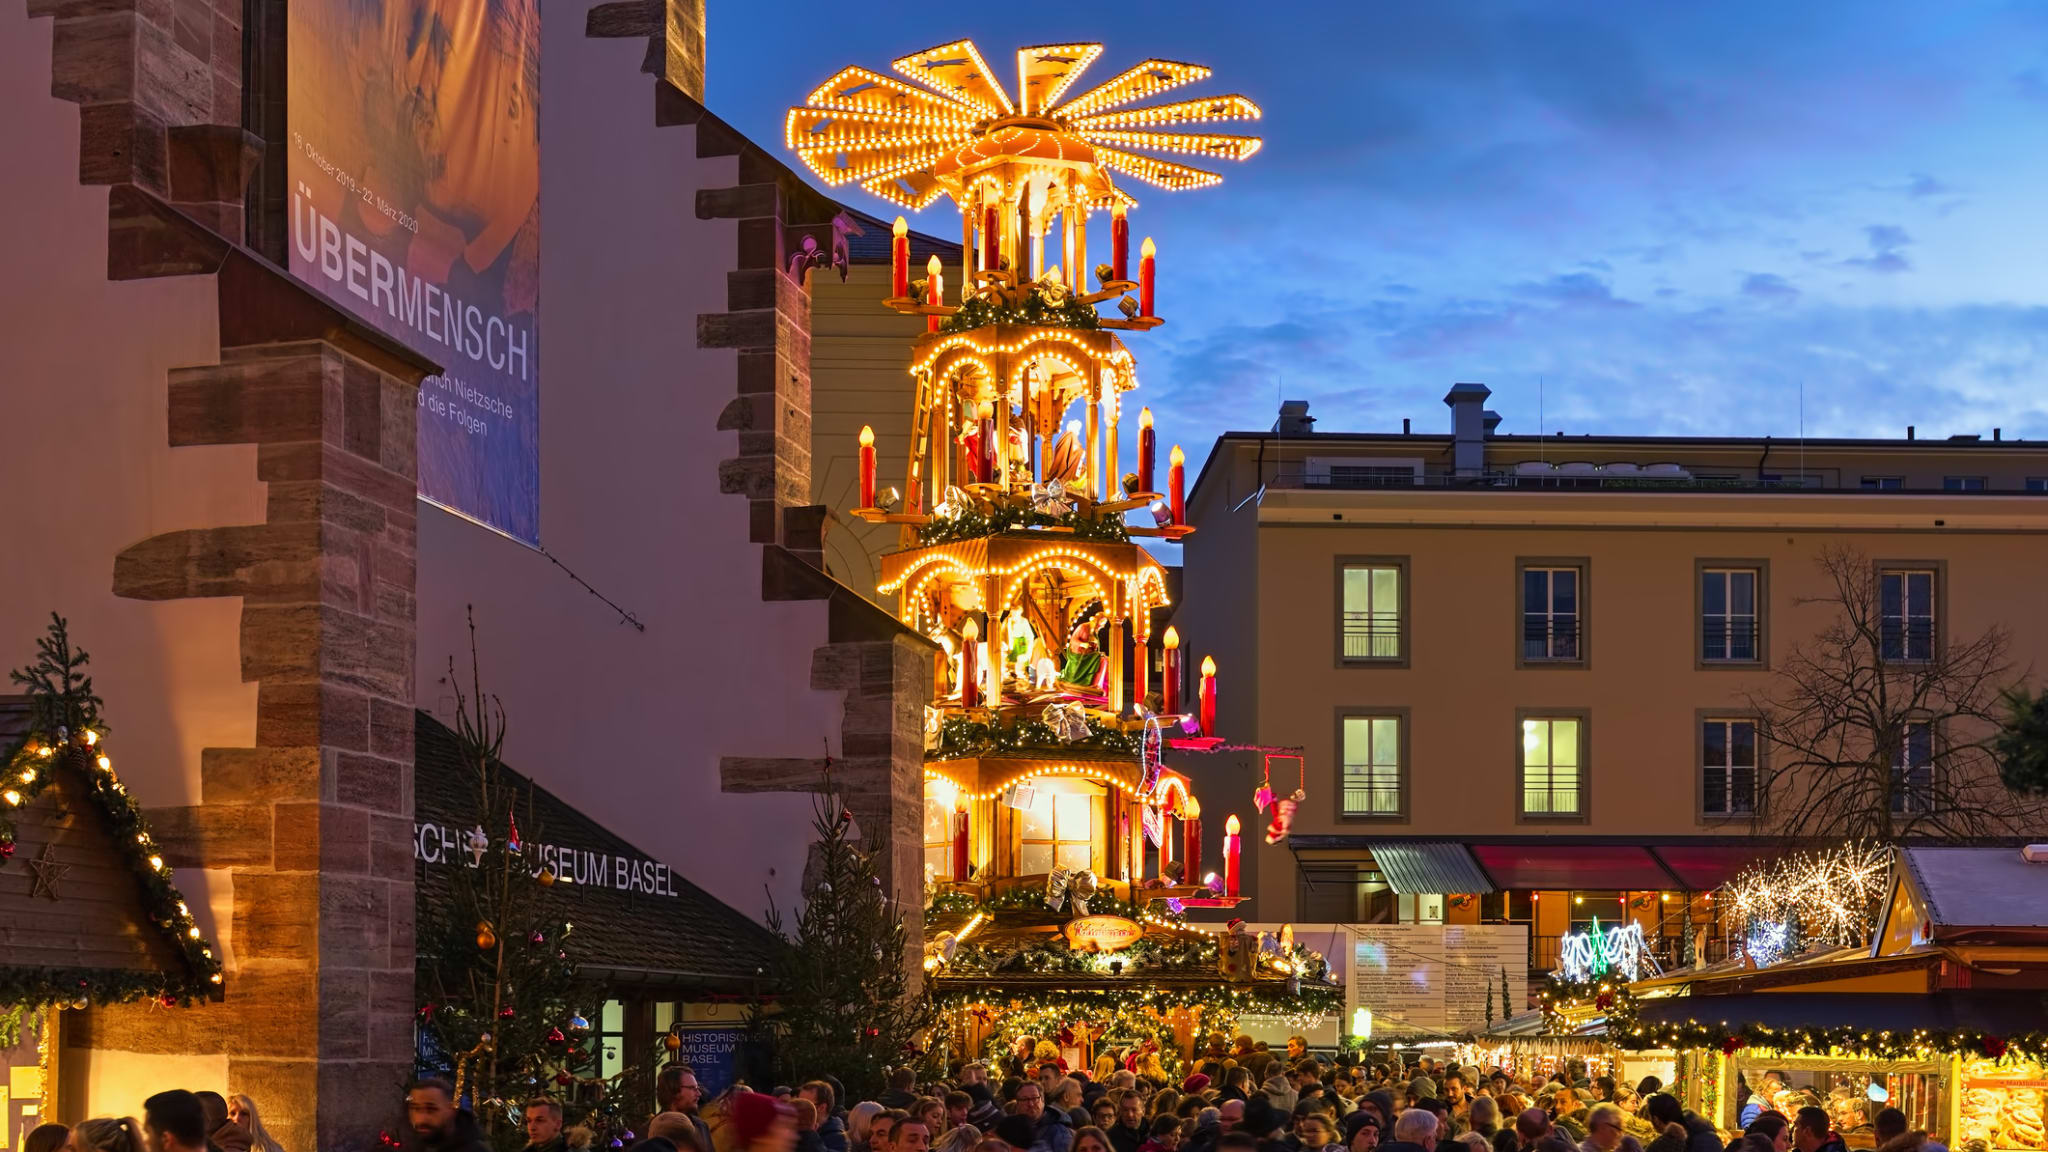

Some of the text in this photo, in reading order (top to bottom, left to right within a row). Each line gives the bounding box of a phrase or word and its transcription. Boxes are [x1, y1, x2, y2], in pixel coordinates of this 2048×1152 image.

[336, 168, 355, 192] 2019
[377, 196, 398, 221] März
[398, 211, 419, 234] 2020
[294, 180, 527, 381] ÜBERMENSCH
[428, 394, 446, 417] die
[449, 402, 488, 437] Folgen
[455, 378, 513, 419] Nietzsche
[615, 856, 678, 897] BASEL
[682, 1044, 736, 1054] MUSEUM
[682, 1054, 721, 1064] BASEL
